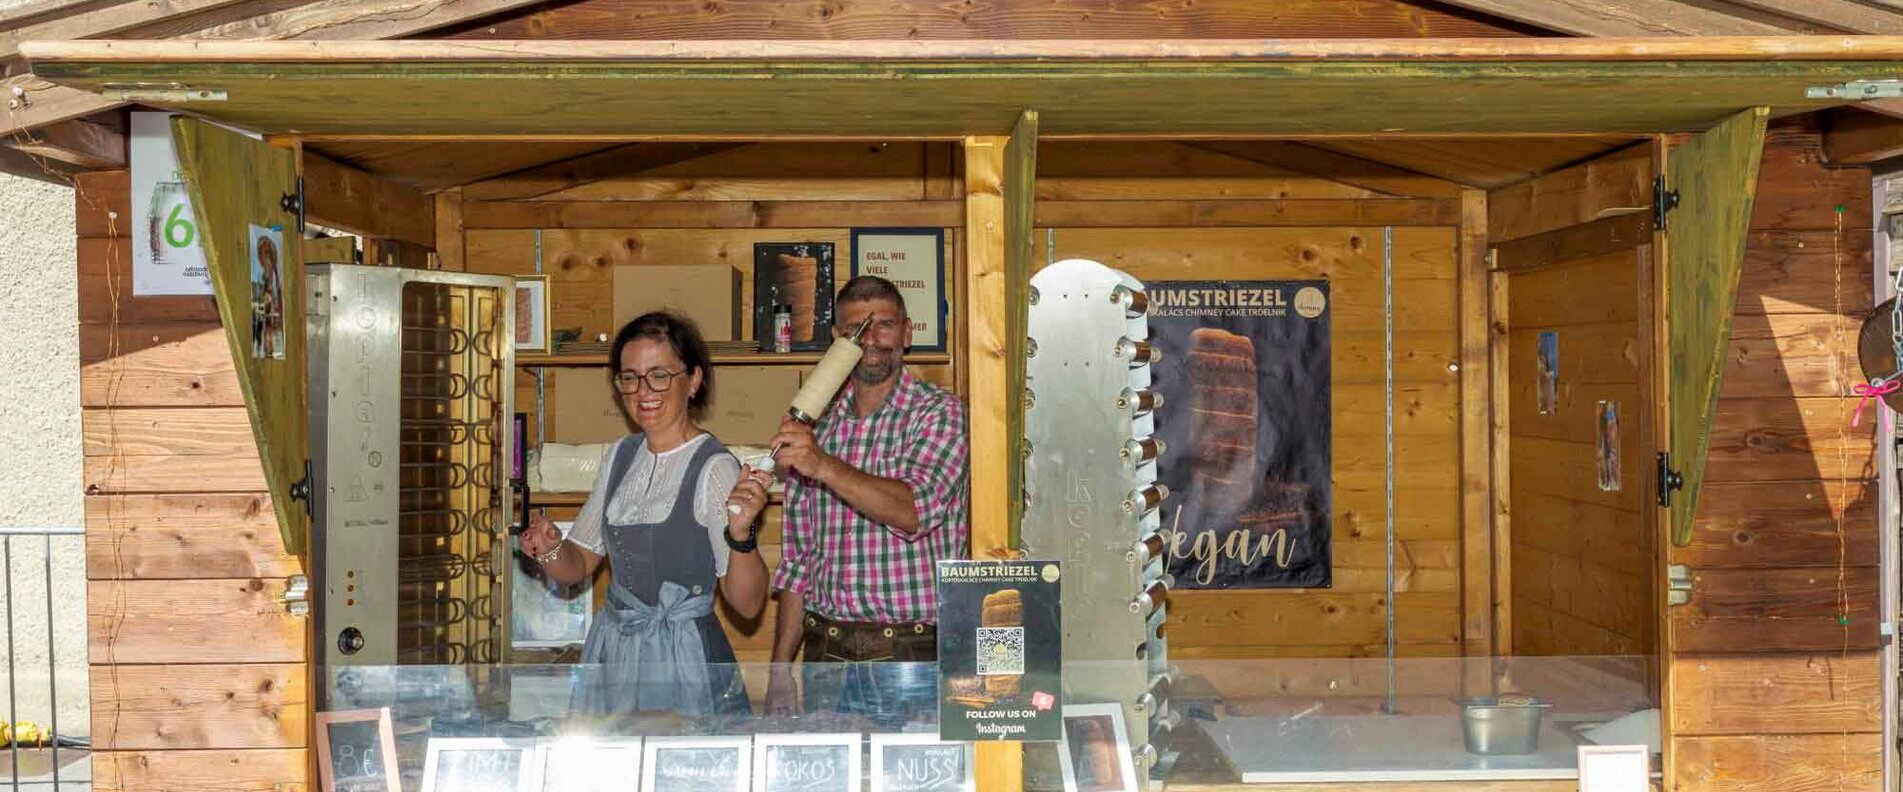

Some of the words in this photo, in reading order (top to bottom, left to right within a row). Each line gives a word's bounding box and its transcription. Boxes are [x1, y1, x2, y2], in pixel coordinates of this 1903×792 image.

[891, 252, 906, 261] WIE
[866, 265, 888, 274] VIELE
[1149, 288, 1287, 307] UMSTRIEZEL
[1185, 309, 1223, 317] CHIMNEY
[1225, 309, 1246, 317] CAKE
[941, 566, 1038, 577] BAUMSTRIEZEL
[966, 710, 1005, 719] FOLLOW
[1007, 710, 1020, 718] US
[1022, 709, 1036, 718] ON
[976, 722, 1026, 736] Instagram
